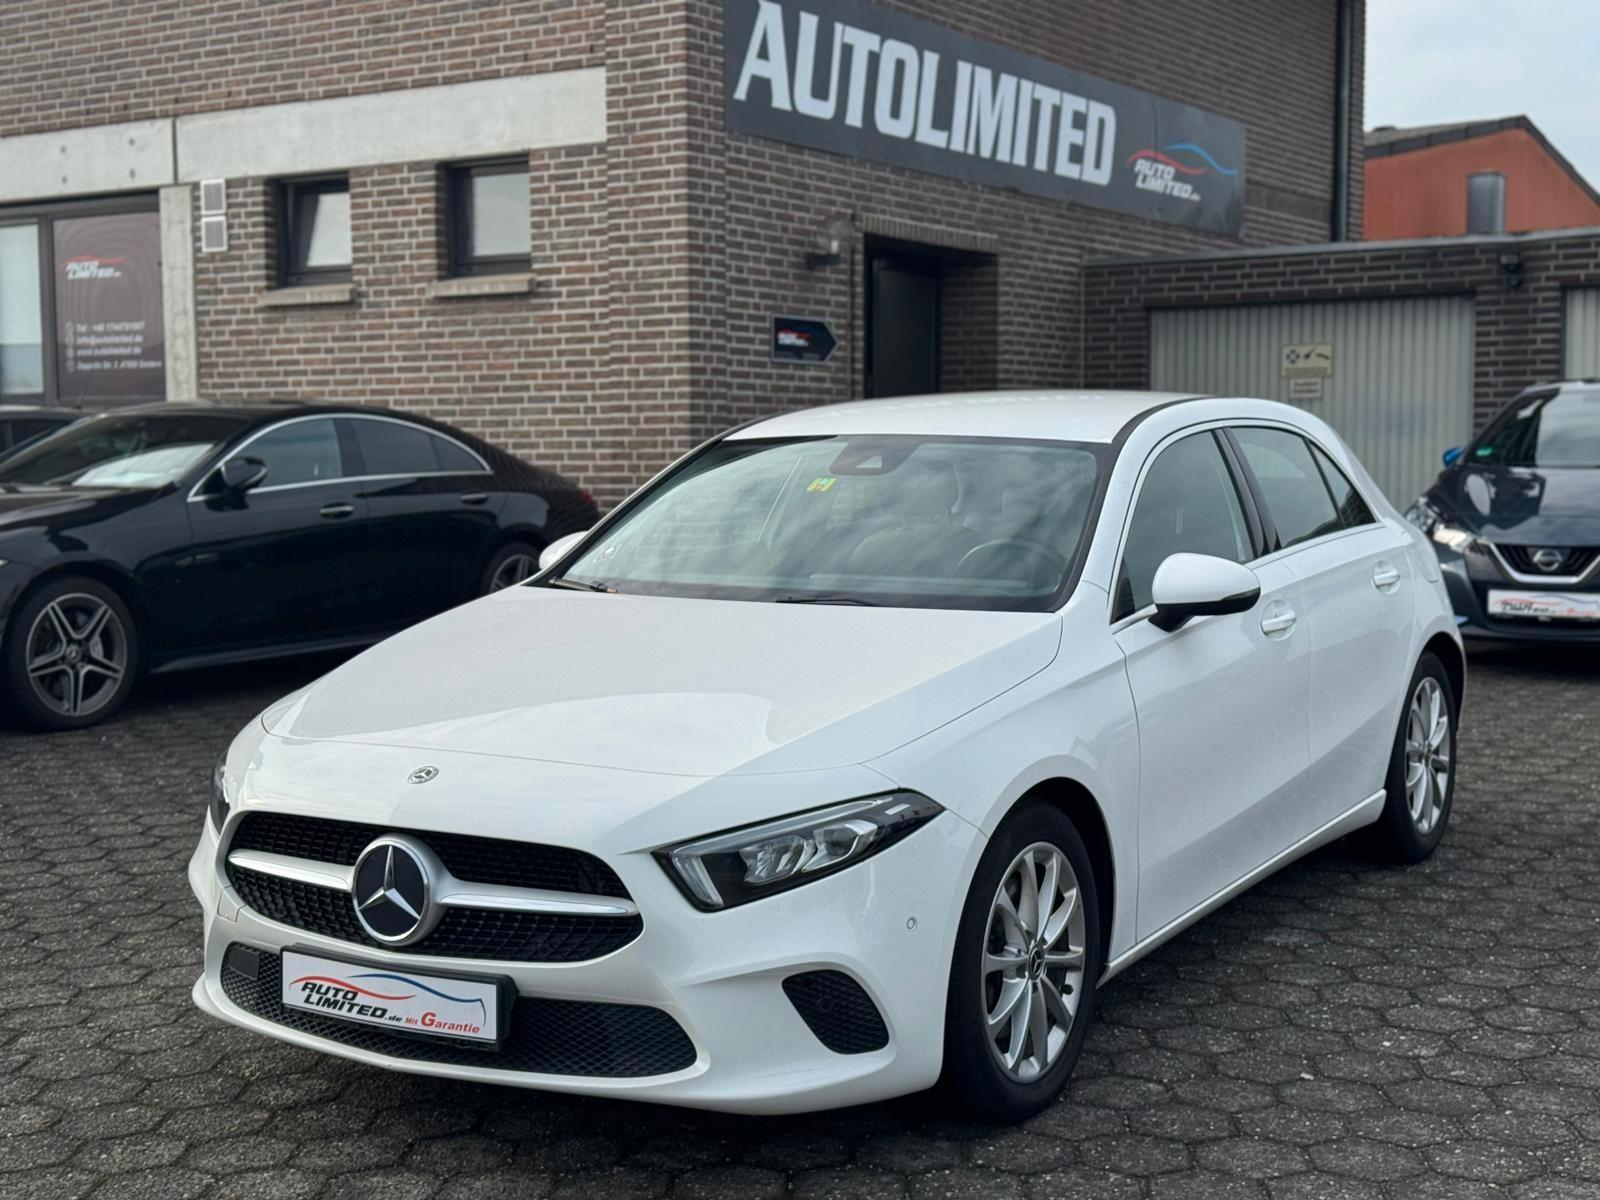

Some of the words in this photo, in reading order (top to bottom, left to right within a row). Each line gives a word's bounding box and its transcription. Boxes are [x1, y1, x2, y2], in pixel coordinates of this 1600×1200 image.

[733, 0, 1117, 186] AUTOLIMITED
[1134, 158, 1176, 180] AUTO
[301, 981, 358, 1001] AUTO
[303, 993, 403, 1022] LIMITED.de
[404, 1016, 418, 1025] Mit
[421, 1012, 480, 1034] Garantie
